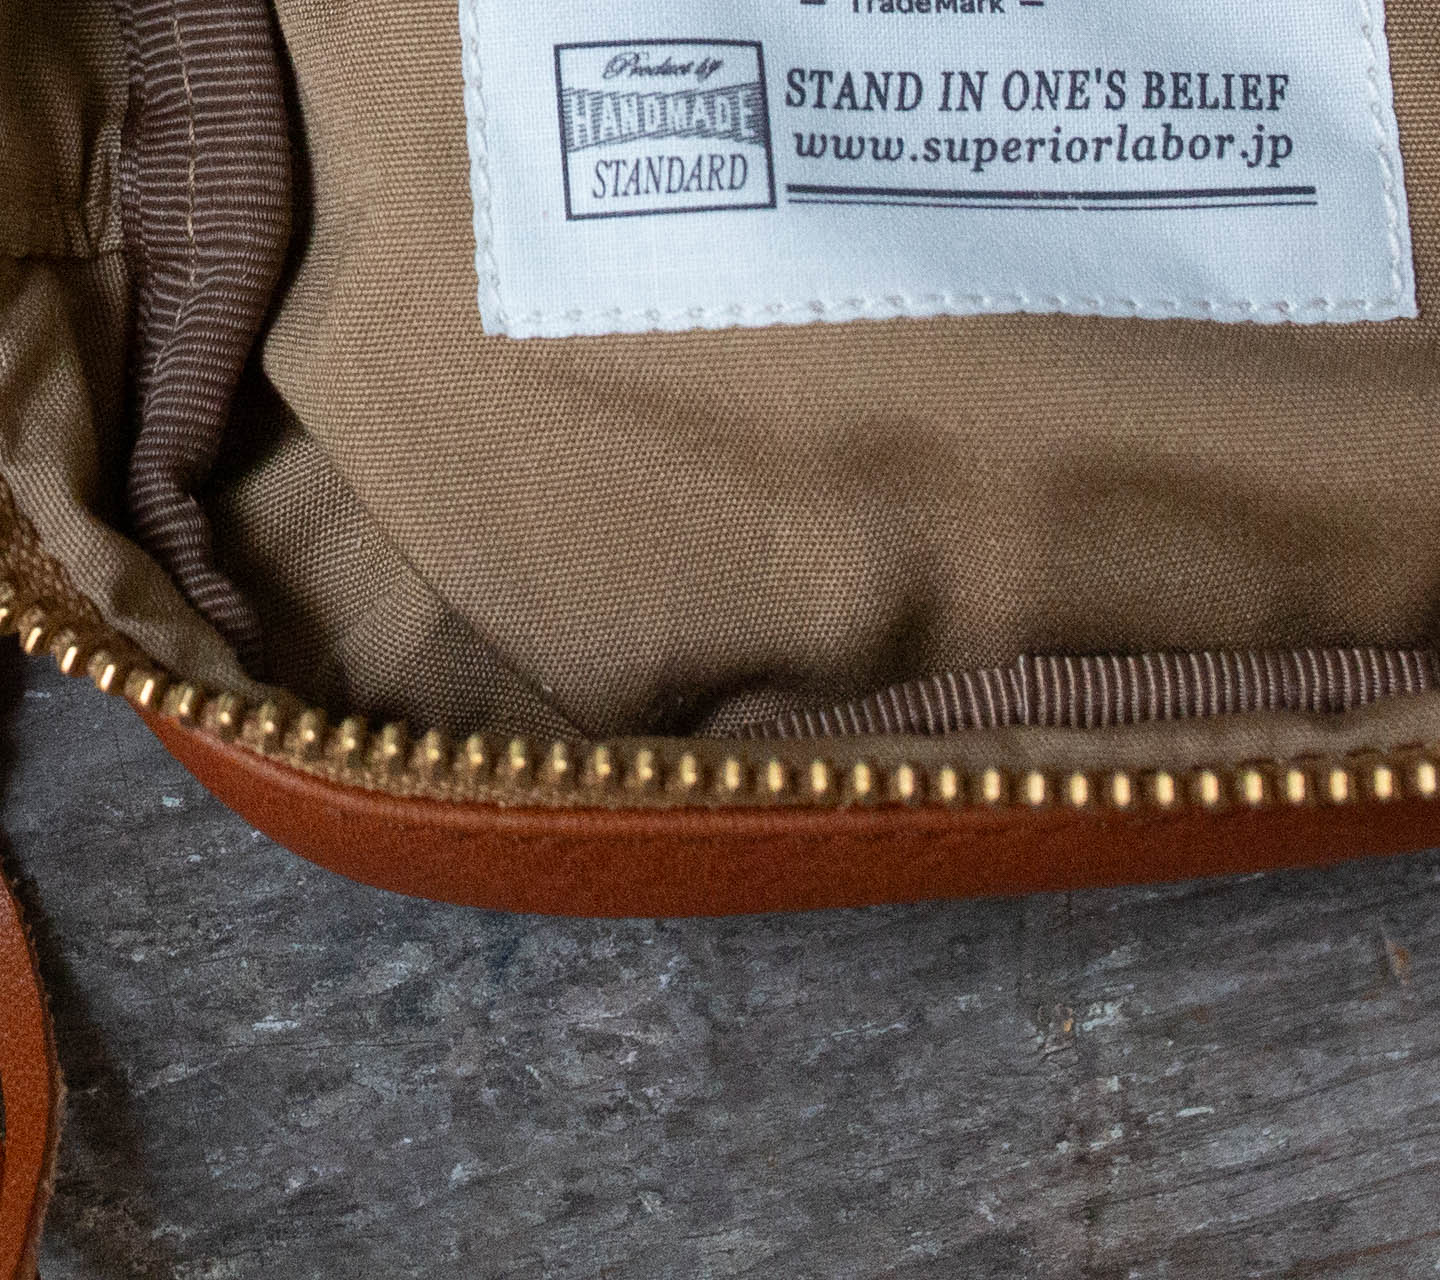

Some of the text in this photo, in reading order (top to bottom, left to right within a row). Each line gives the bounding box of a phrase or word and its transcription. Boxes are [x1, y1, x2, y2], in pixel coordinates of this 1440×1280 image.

[785, 66, 1289, 112] STAND IN ONE'S BELIEF
[570, 89, 758, 146] HANDMADE
[793, 123, 1294, 172] www.superiorlabor.jp
[592, 152, 748, 199] STANDARD
